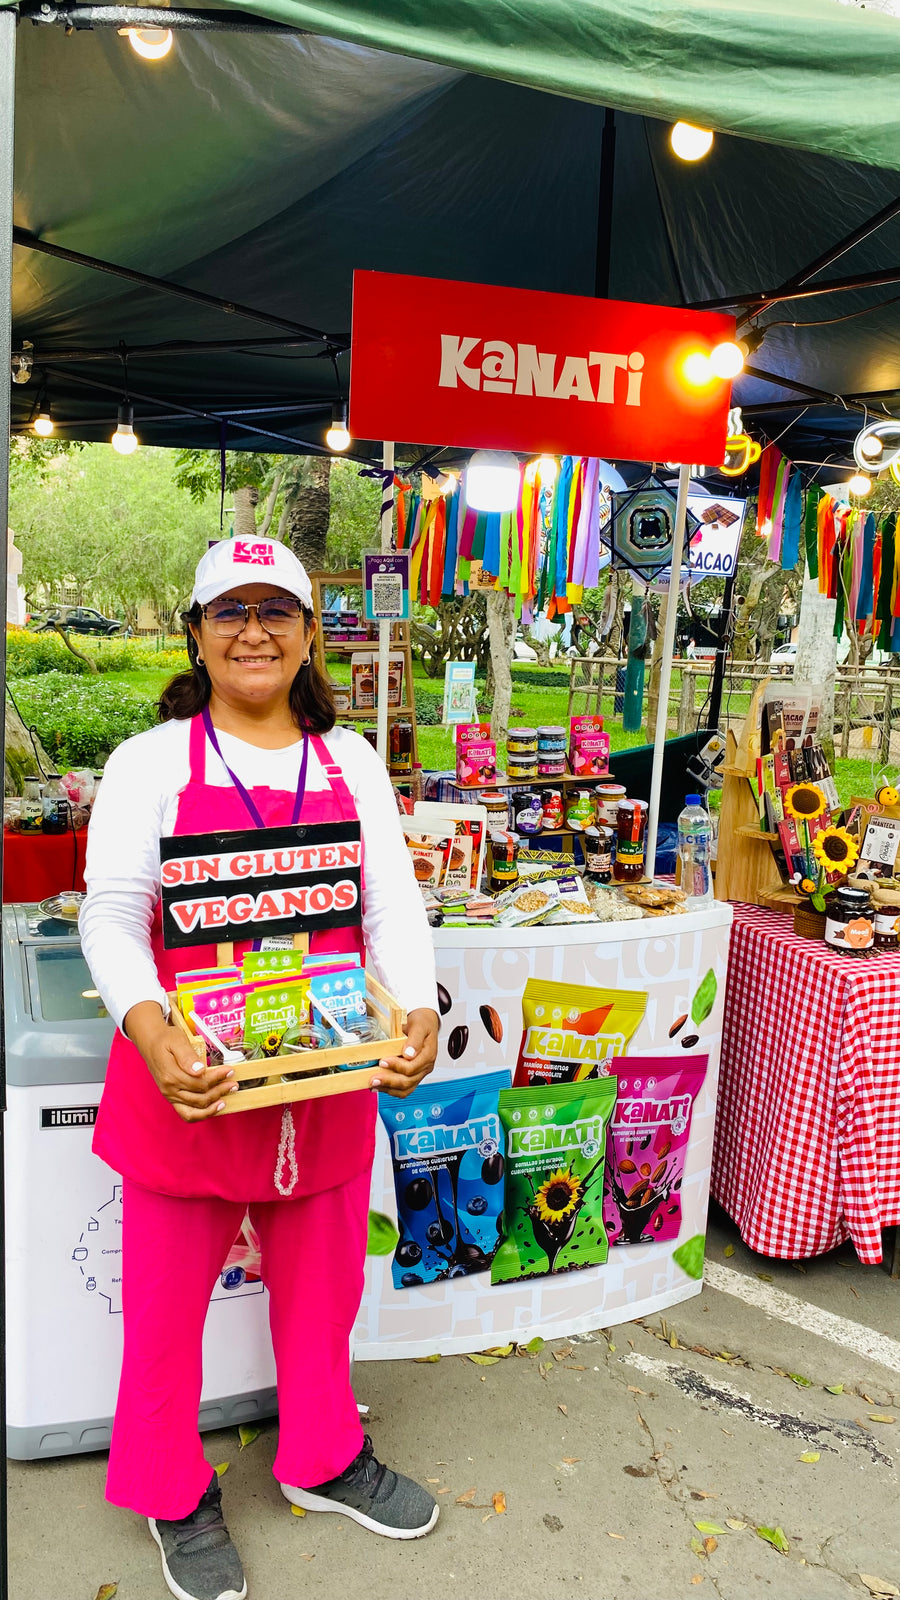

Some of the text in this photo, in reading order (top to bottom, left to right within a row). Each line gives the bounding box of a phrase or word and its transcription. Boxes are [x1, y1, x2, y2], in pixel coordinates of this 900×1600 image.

[162, 844, 360, 884] SIN GLUTEN
[173, 884, 355, 929] VEGANOS
[534, 1070, 563, 1078] CHOCOLATE
[51, 1109, 95, 1125] ilumi
